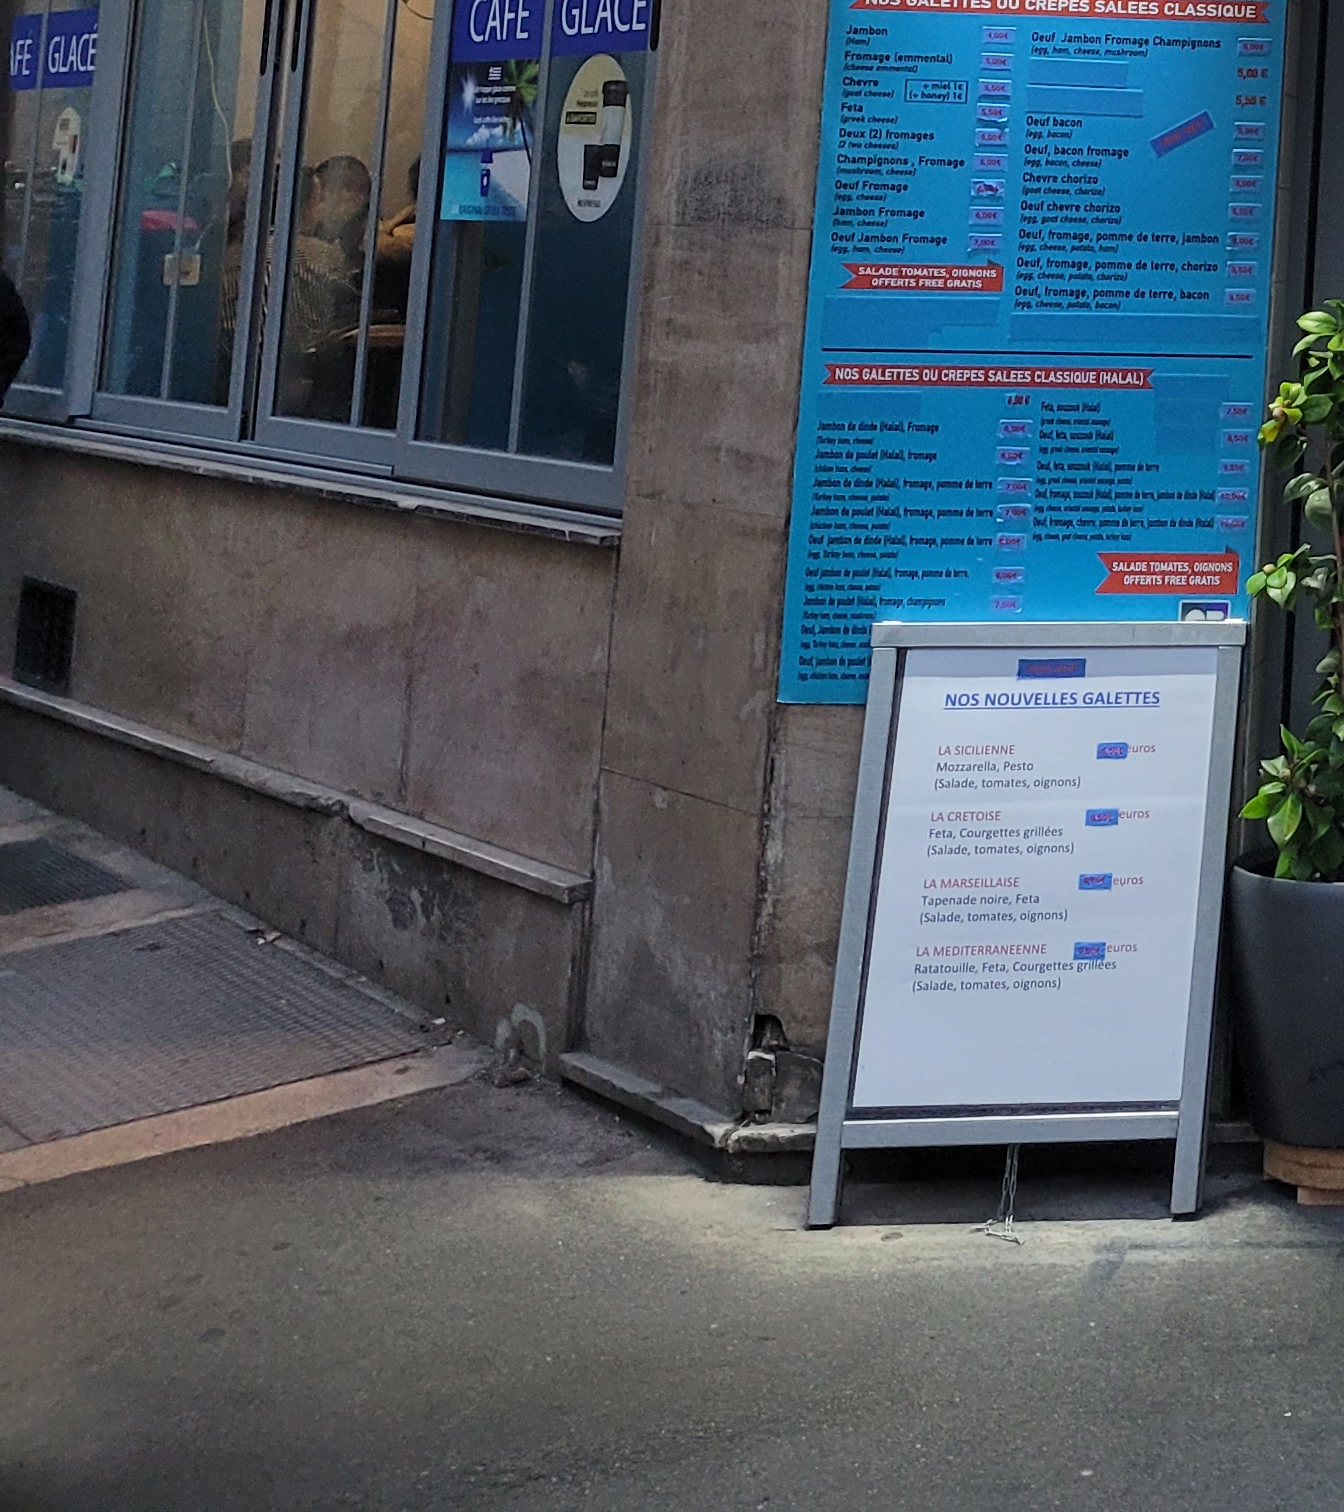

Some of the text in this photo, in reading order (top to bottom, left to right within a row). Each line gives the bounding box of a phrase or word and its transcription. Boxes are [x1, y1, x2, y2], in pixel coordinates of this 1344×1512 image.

[1095, 0, 1158, 15] SALEES
[1164, 3, 1256, 19] CLASSIQUE
[846, 26, 888, 36] Jambon
[48, 23, 98, 73] GLACÉ
[844, 51, 953, 64] Fromage (emmental)
[841, 102, 863, 113] Feta
[1026, 116, 1082, 128] Oeuf bacon
[839, 128, 934, 142] Deux (2) fromages
[833, 207, 925, 218] Jambon Fromage
[858, 267, 997, 278] SALADE TOMATES, OIGNONS
[872, 278, 982, 288] OFFERTS FREE GRATIS
[834, 367, 1144, 385] NOS GALETTES OU CREPES SALEES CLASSIQUE (HALAL)
[1112, 562, 1233, 573] SALADE TOMATES, OIGNONS
[1124, 575, 1220, 585] OFFERTS FREE GRATIS
[945, 691, 1161, 708] NOS NOUVELLES GALETTES
[938, 744, 1015, 756] LA SICILIENNE
[936, 760, 1034, 774] Mozzarella, Pesto
[934, 775, 1081, 791] (Salade, tomates, oignons)
[930, 810, 1001, 822] LA CRETOISE
[1119, 808, 1150, 820] euros
[929, 825, 1063, 840] Feta, Courgettes grillées
[927, 842, 1075, 858] (Salade, tomates, oignons)
[923, 876, 1020, 889] LA MARSEILLAISE
[1112, 875, 1144, 887] euros
[921, 892, 1040, 908] Tapenade noire, Feta
[920, 909, 1069, 925] (Salade, tomates, oignons)
[916, 943, 1047, 957] LA MEDITERRANEENNE
[1106, 942, 1138, 953] euros
[914, 958, 1117, 975] Ratatouille, Feta, Courgettes grillées
[912, 976, 1061, 993] (Salade, tomates, oignons)
